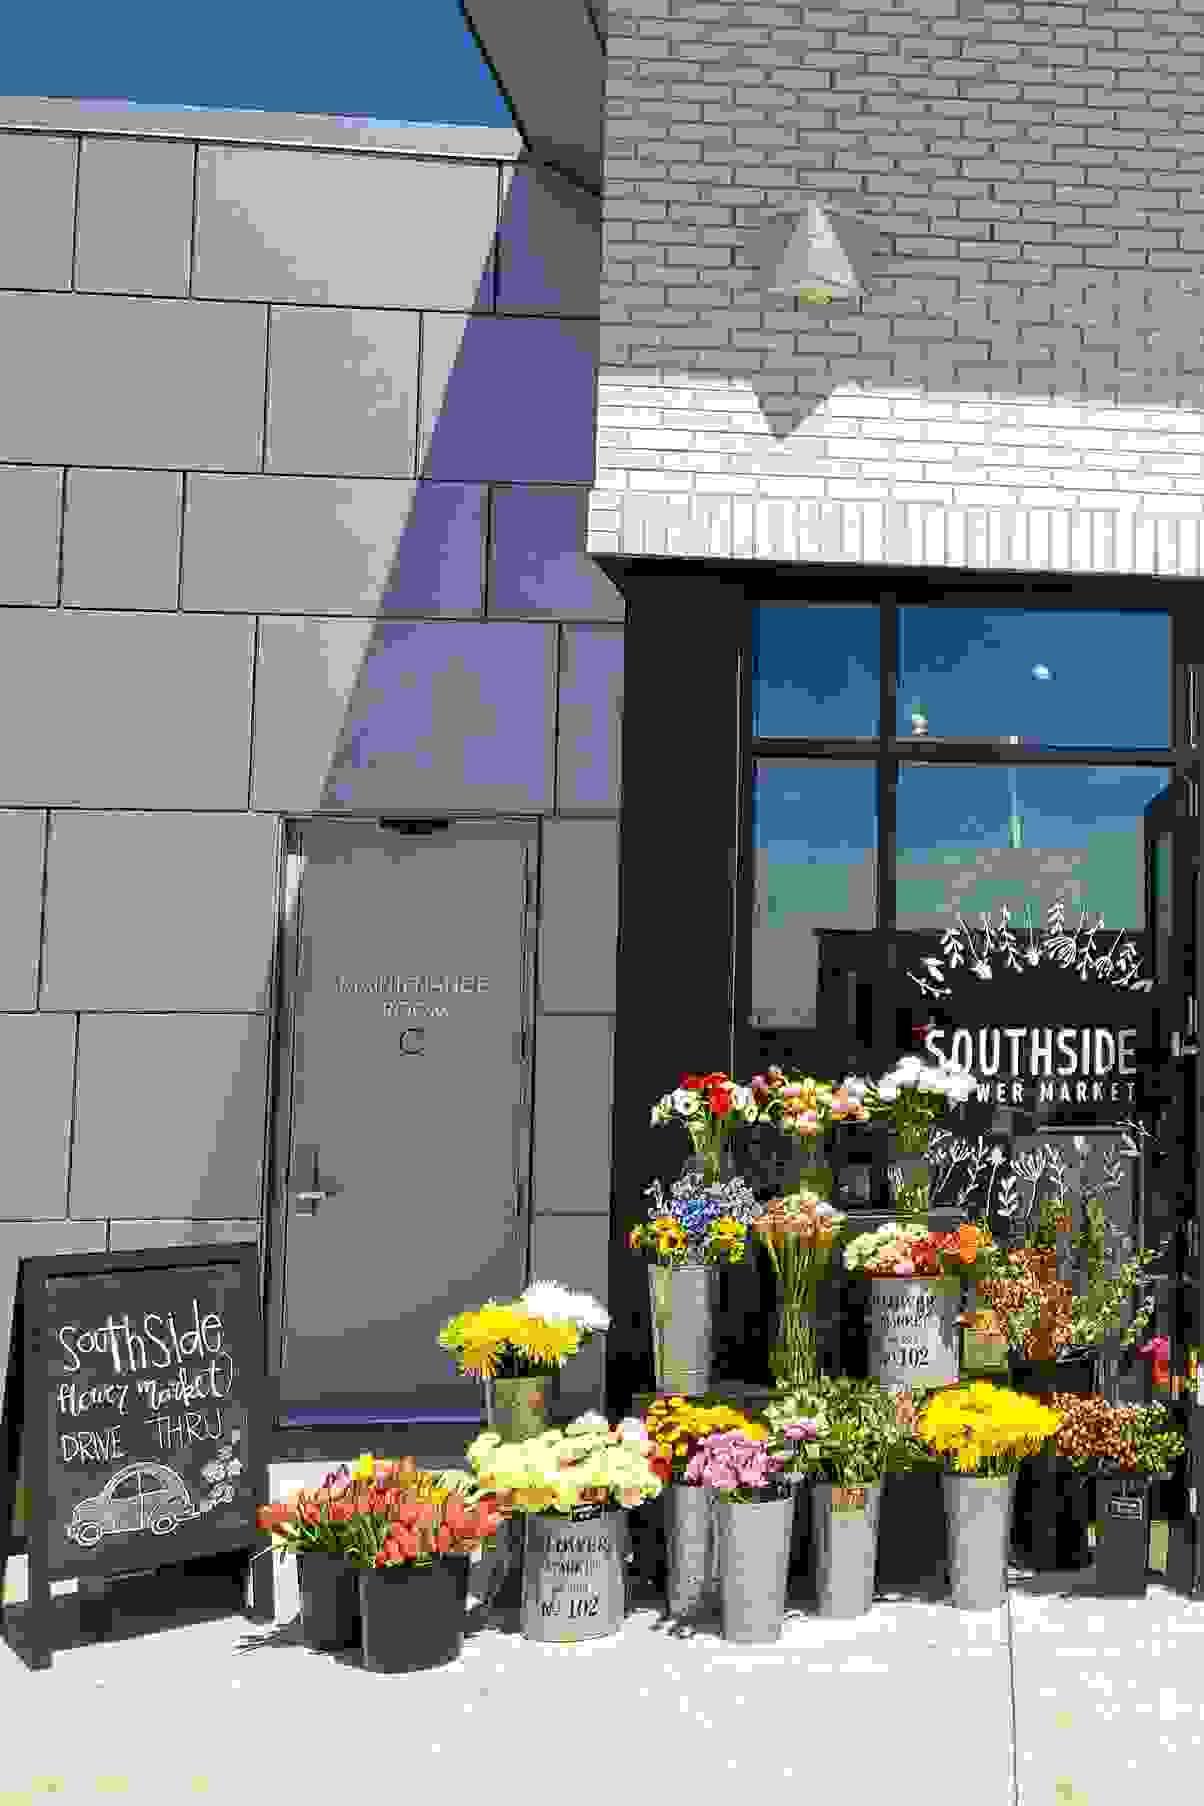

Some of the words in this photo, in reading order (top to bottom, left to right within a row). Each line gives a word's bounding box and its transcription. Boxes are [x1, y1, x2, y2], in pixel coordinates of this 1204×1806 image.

[926, 1026, 1137, 1076] SOUTHSIDE
[1040, 1081, 1136, 1103] MARKET
[60, 1424, 126, 1465] DRIVE
[144, 1408, 224, 1450] THRU
